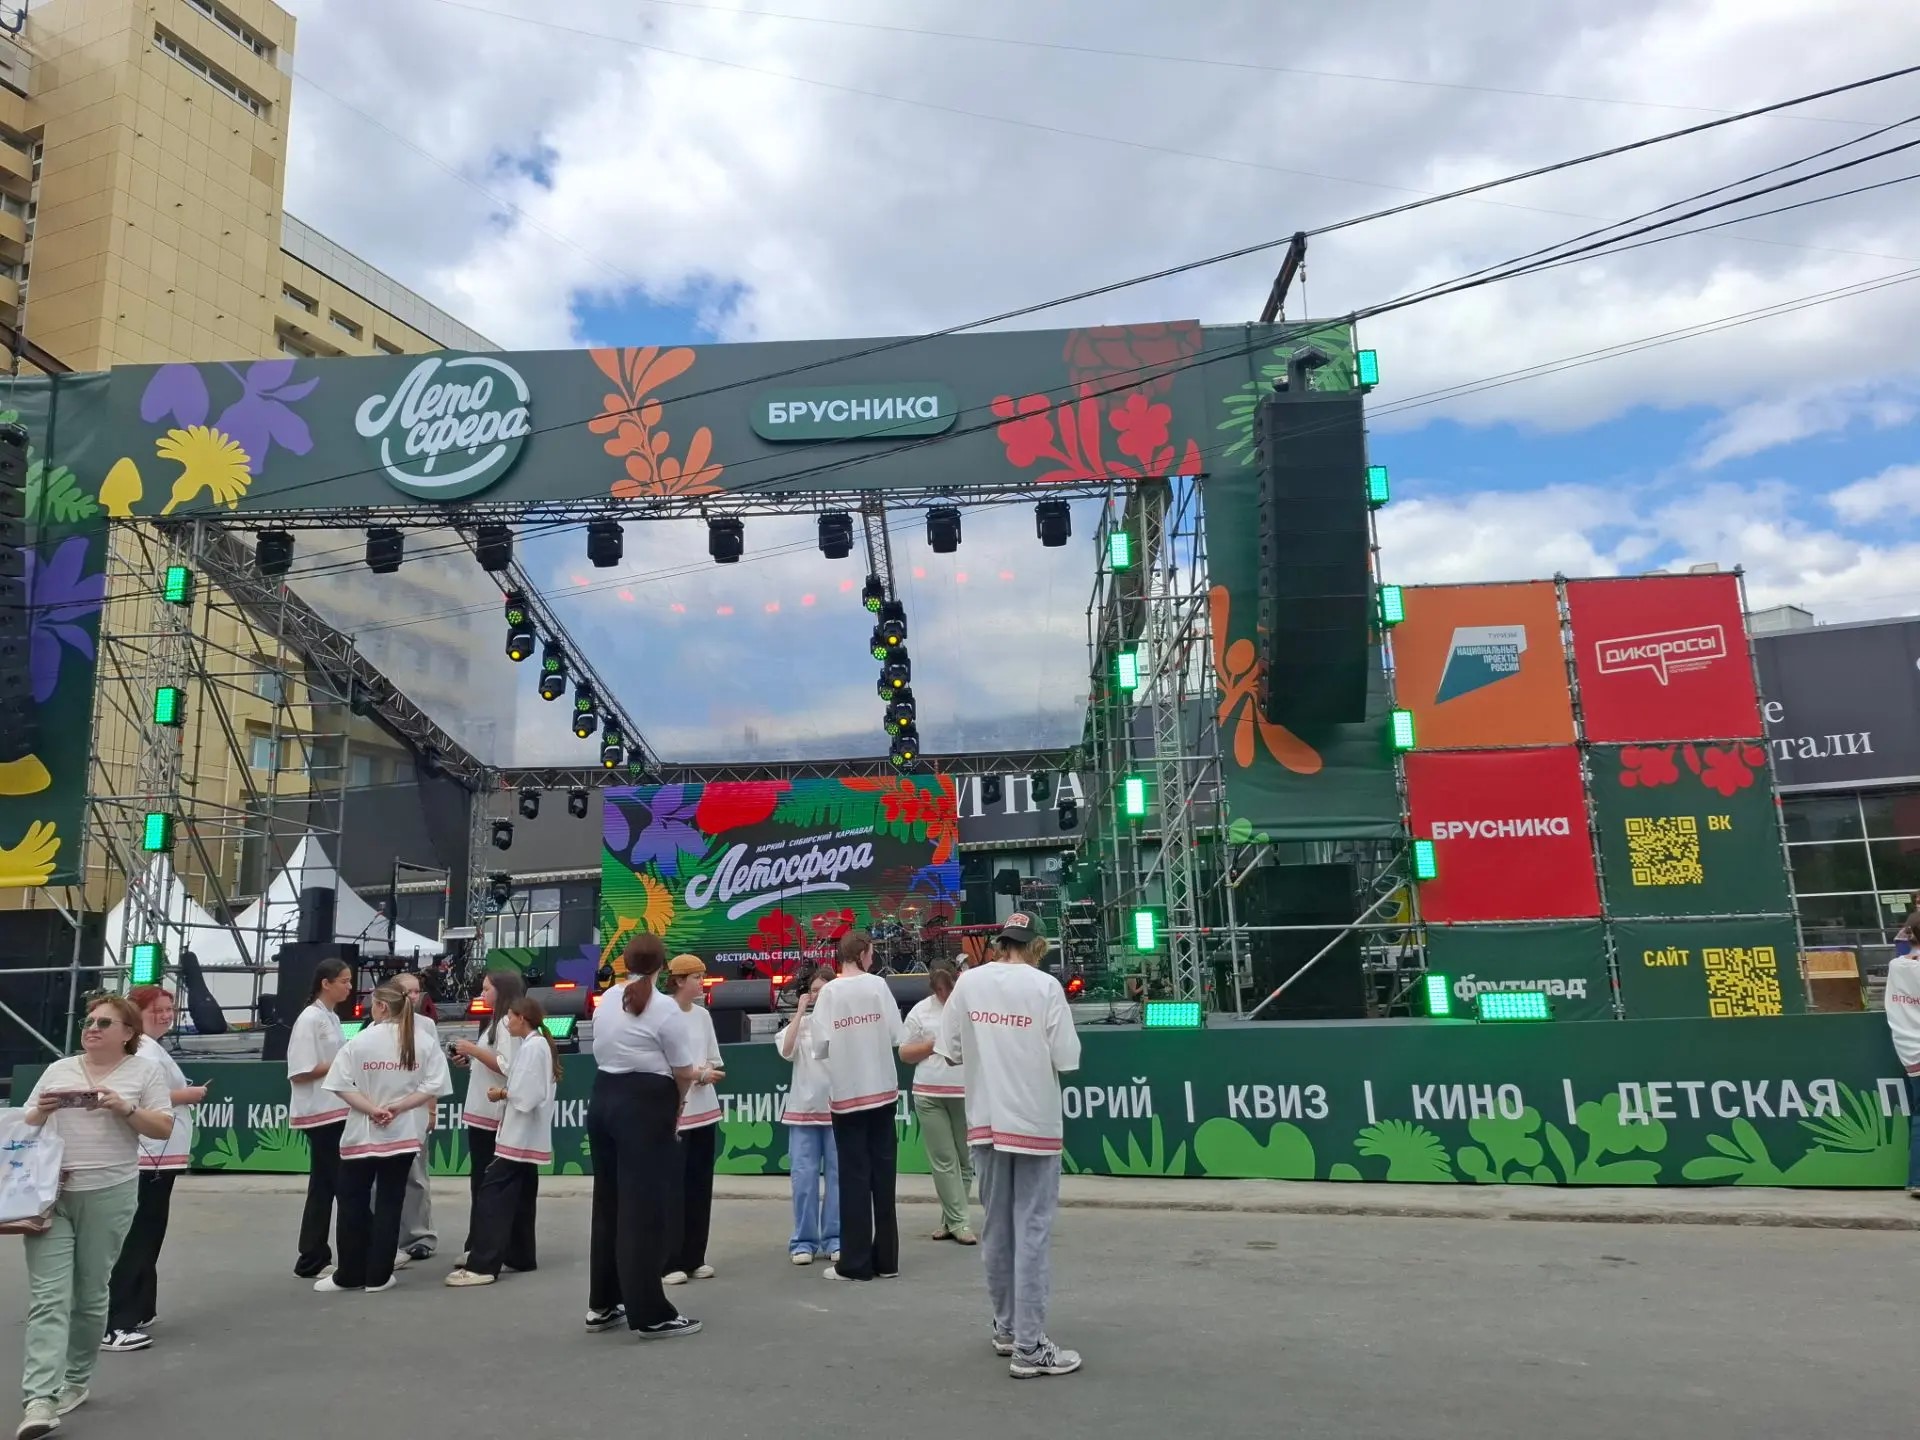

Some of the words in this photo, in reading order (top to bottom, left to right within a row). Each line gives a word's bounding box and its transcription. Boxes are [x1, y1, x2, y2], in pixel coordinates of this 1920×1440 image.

[1606, 635, 1716, 663] ДИКОРОСЫ
[1708, 815, 1732, 830] ВК
[715, 951, 771, 962] ФЕСТИВАЛЬ
[1644, 946, 1690, 967] САЙТ
[834, 1013, 881, 1030] ВОЛОНТЕР
[363, 1061, 420, 1071] ВОЛОНР
[1227, 1084, 1330, 1119] КВИЗ
[1411, 1083, 1525, 1120] КИНО
[1617, 1078, 1842, 1127] ДЕТСКАЯ
